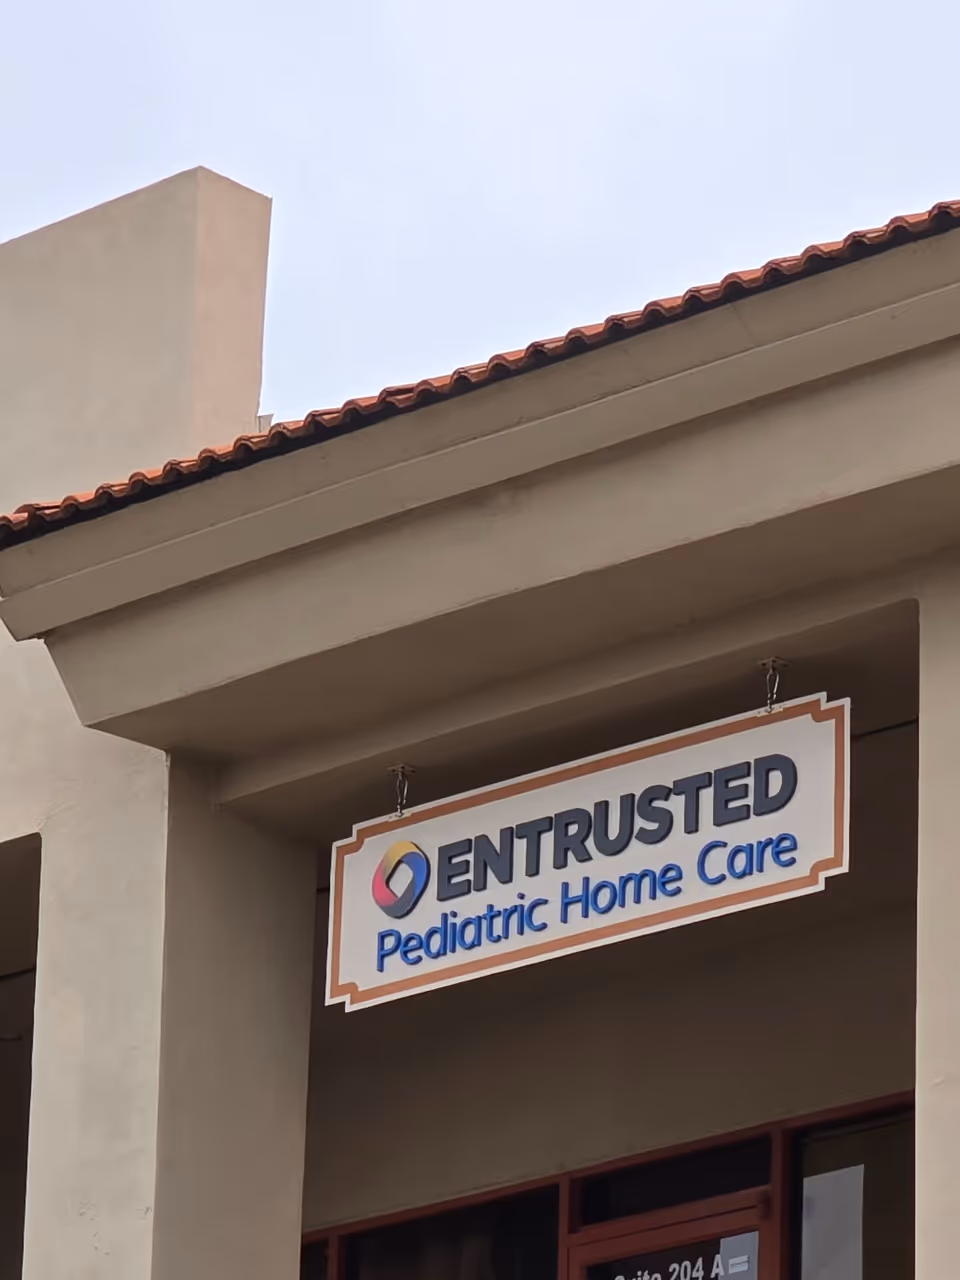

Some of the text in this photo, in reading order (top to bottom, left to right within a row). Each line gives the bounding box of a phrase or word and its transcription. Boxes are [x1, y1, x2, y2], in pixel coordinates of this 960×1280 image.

[436, 753, 798, 901] ENTRUSTED
[376, 832, 798, 972] Pediatric Home Care
[710, 1253, 724, 1278] A
